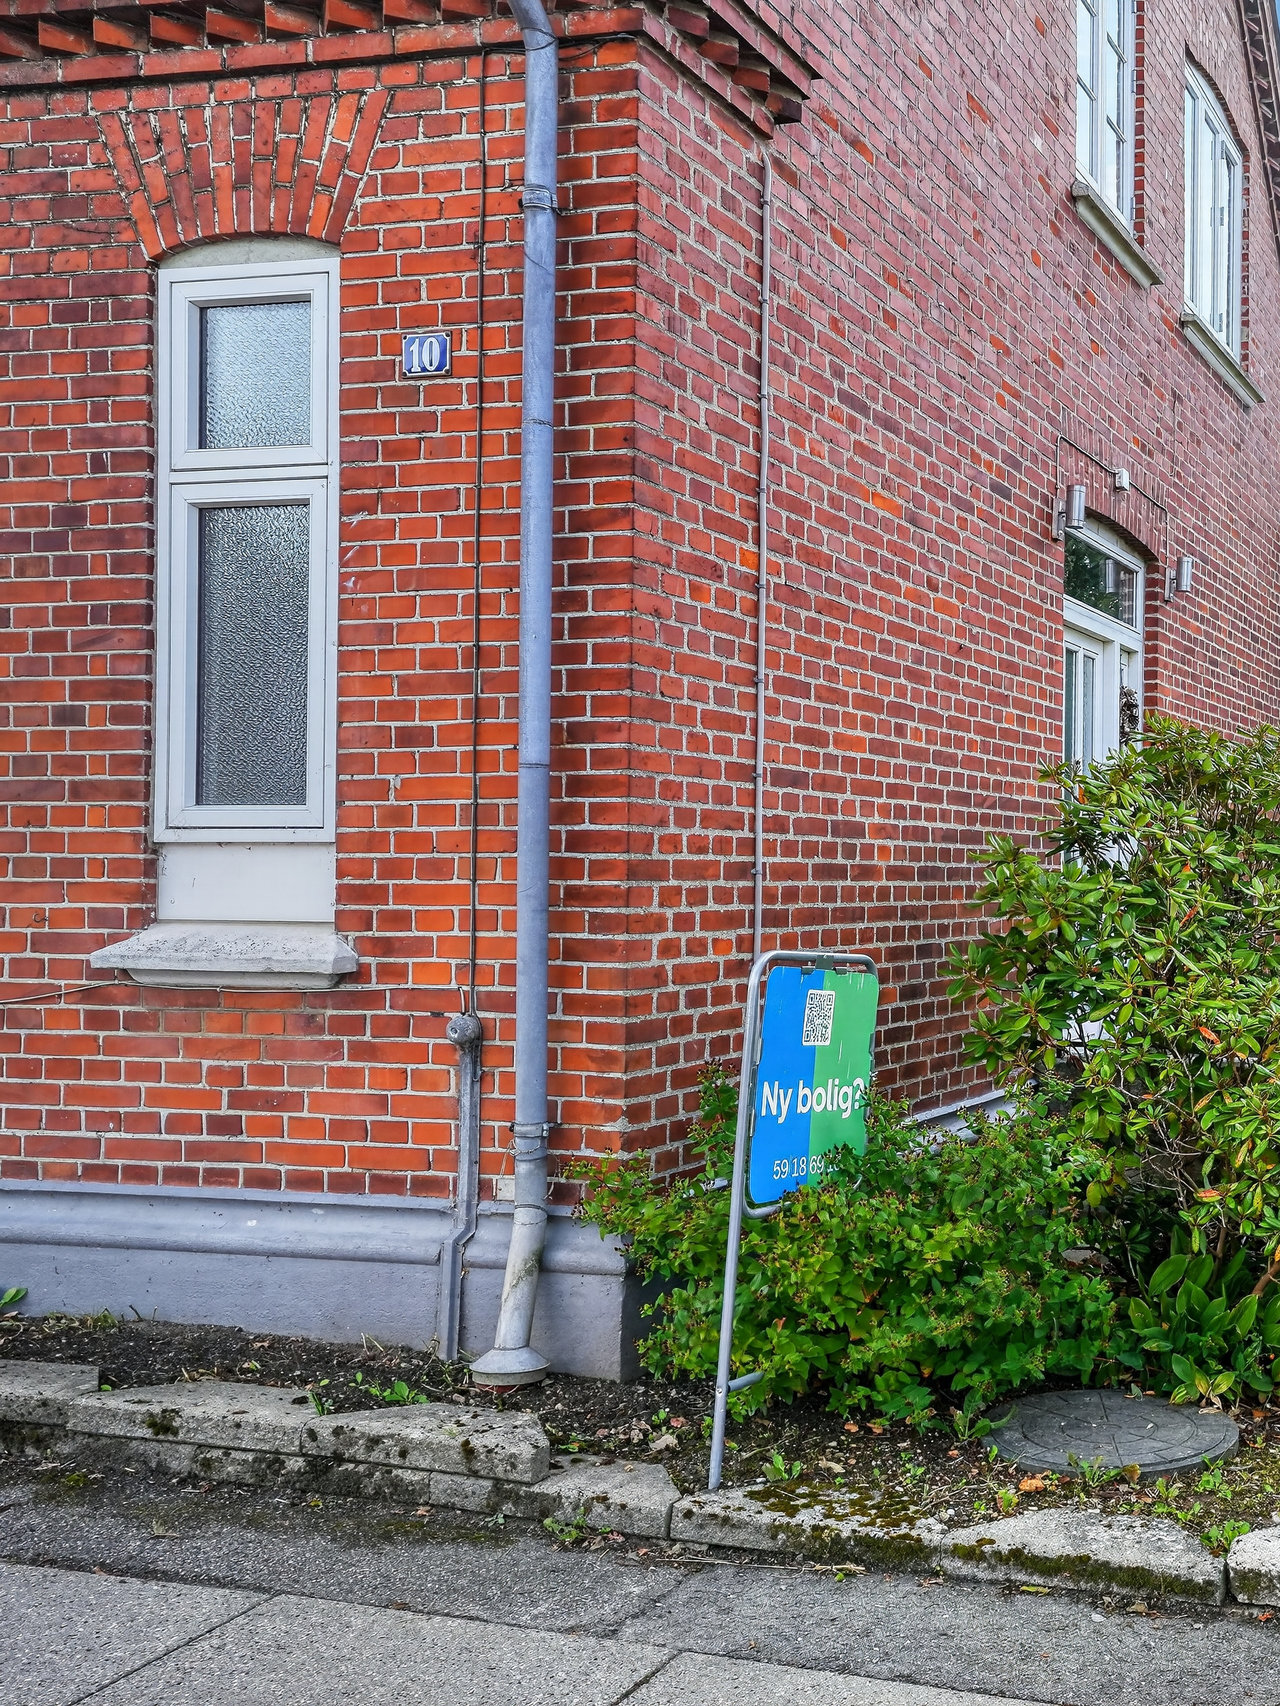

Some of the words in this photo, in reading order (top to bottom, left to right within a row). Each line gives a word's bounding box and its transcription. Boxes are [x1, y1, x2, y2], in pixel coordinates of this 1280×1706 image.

[410, 337, 440, 372] 10
[761, 1081, 793, 1124] Ny
[797, 1077, 865, 1119] bolig?
[773, 1159, 789, 1179] 59
[791, 1156, 807, 1177] 18
[809, 1155, 825, 1174] 69
